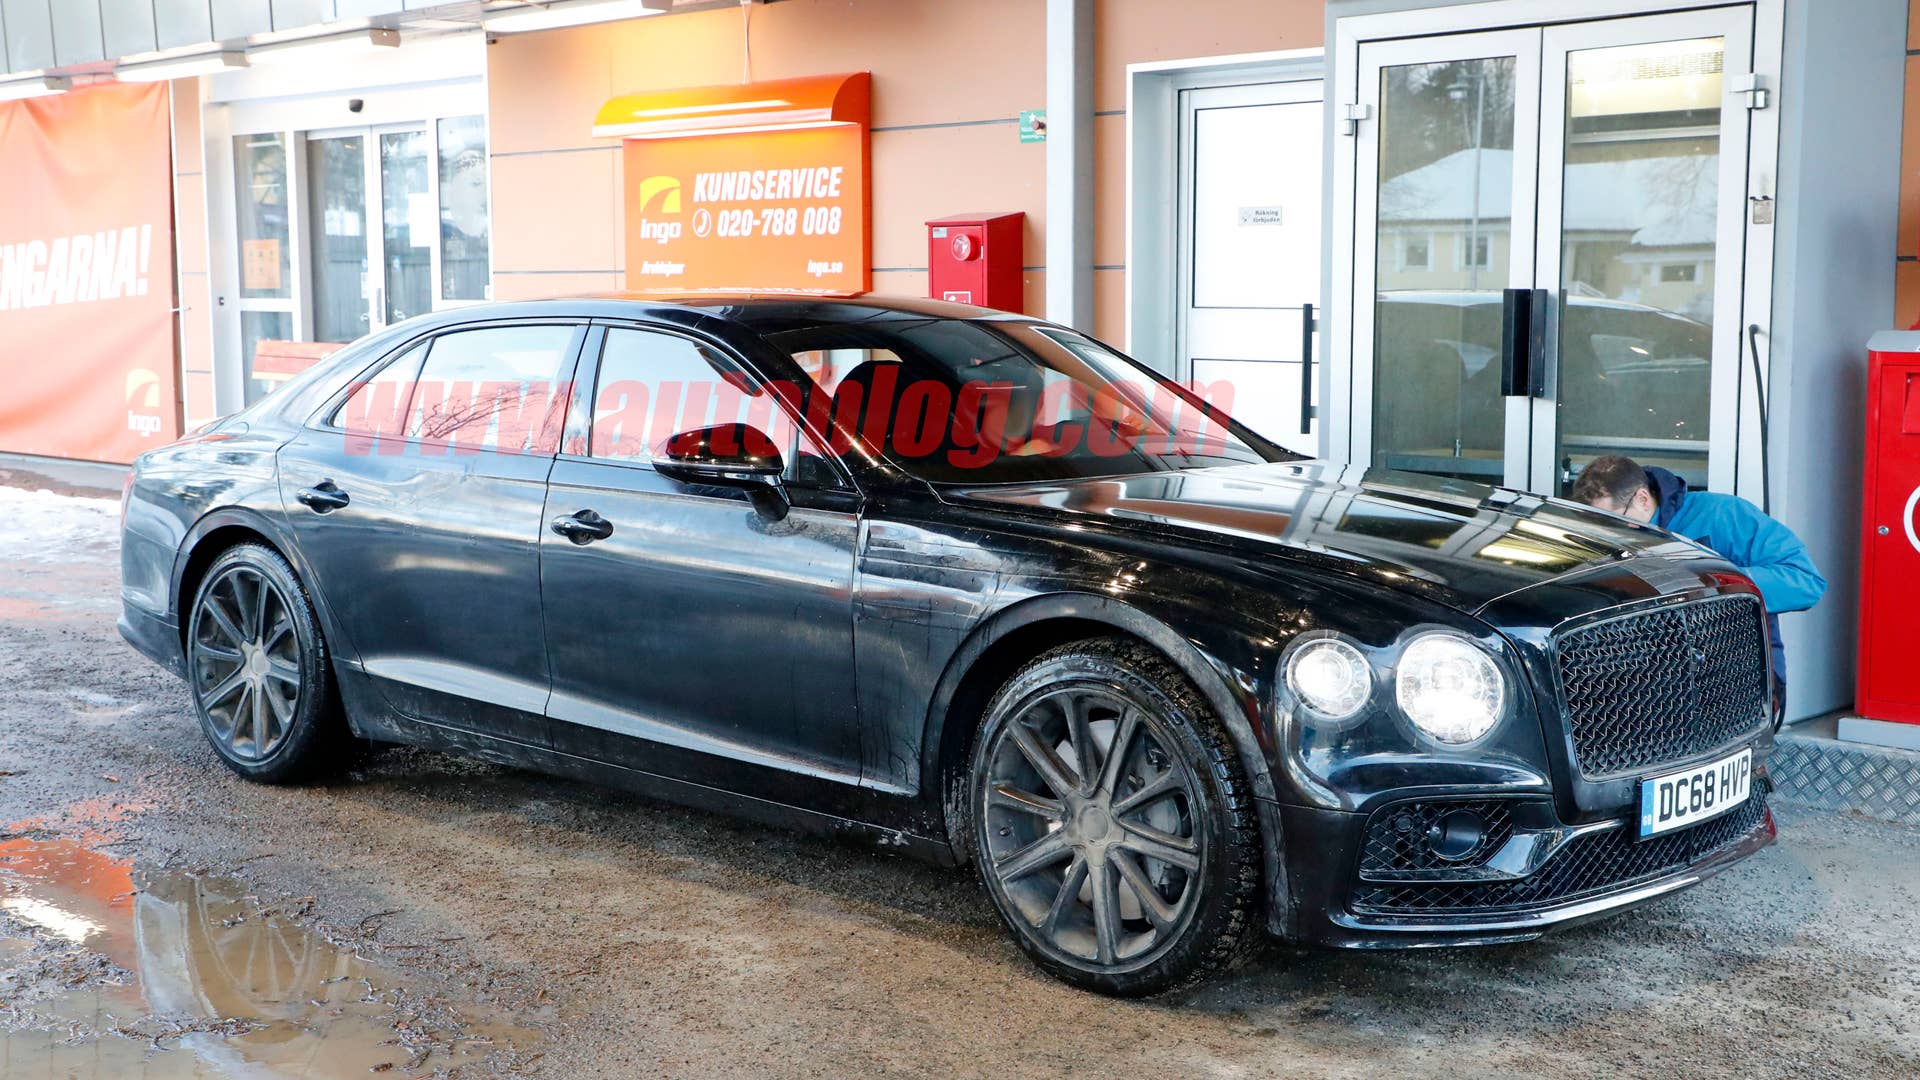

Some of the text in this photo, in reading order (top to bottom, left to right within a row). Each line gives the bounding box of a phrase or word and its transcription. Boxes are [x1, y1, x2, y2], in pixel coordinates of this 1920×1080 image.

[693, 166, 844, 202] KUNDSERVICE
[640, 218, 682, 244] ingo
[717, 206, 842, 237] 020-788 008
[0, 223, 153, 311] NGARNA!
[127, 409, 161, 437] ingo
[1658, 755, 1750, 823] DC68 HVP
